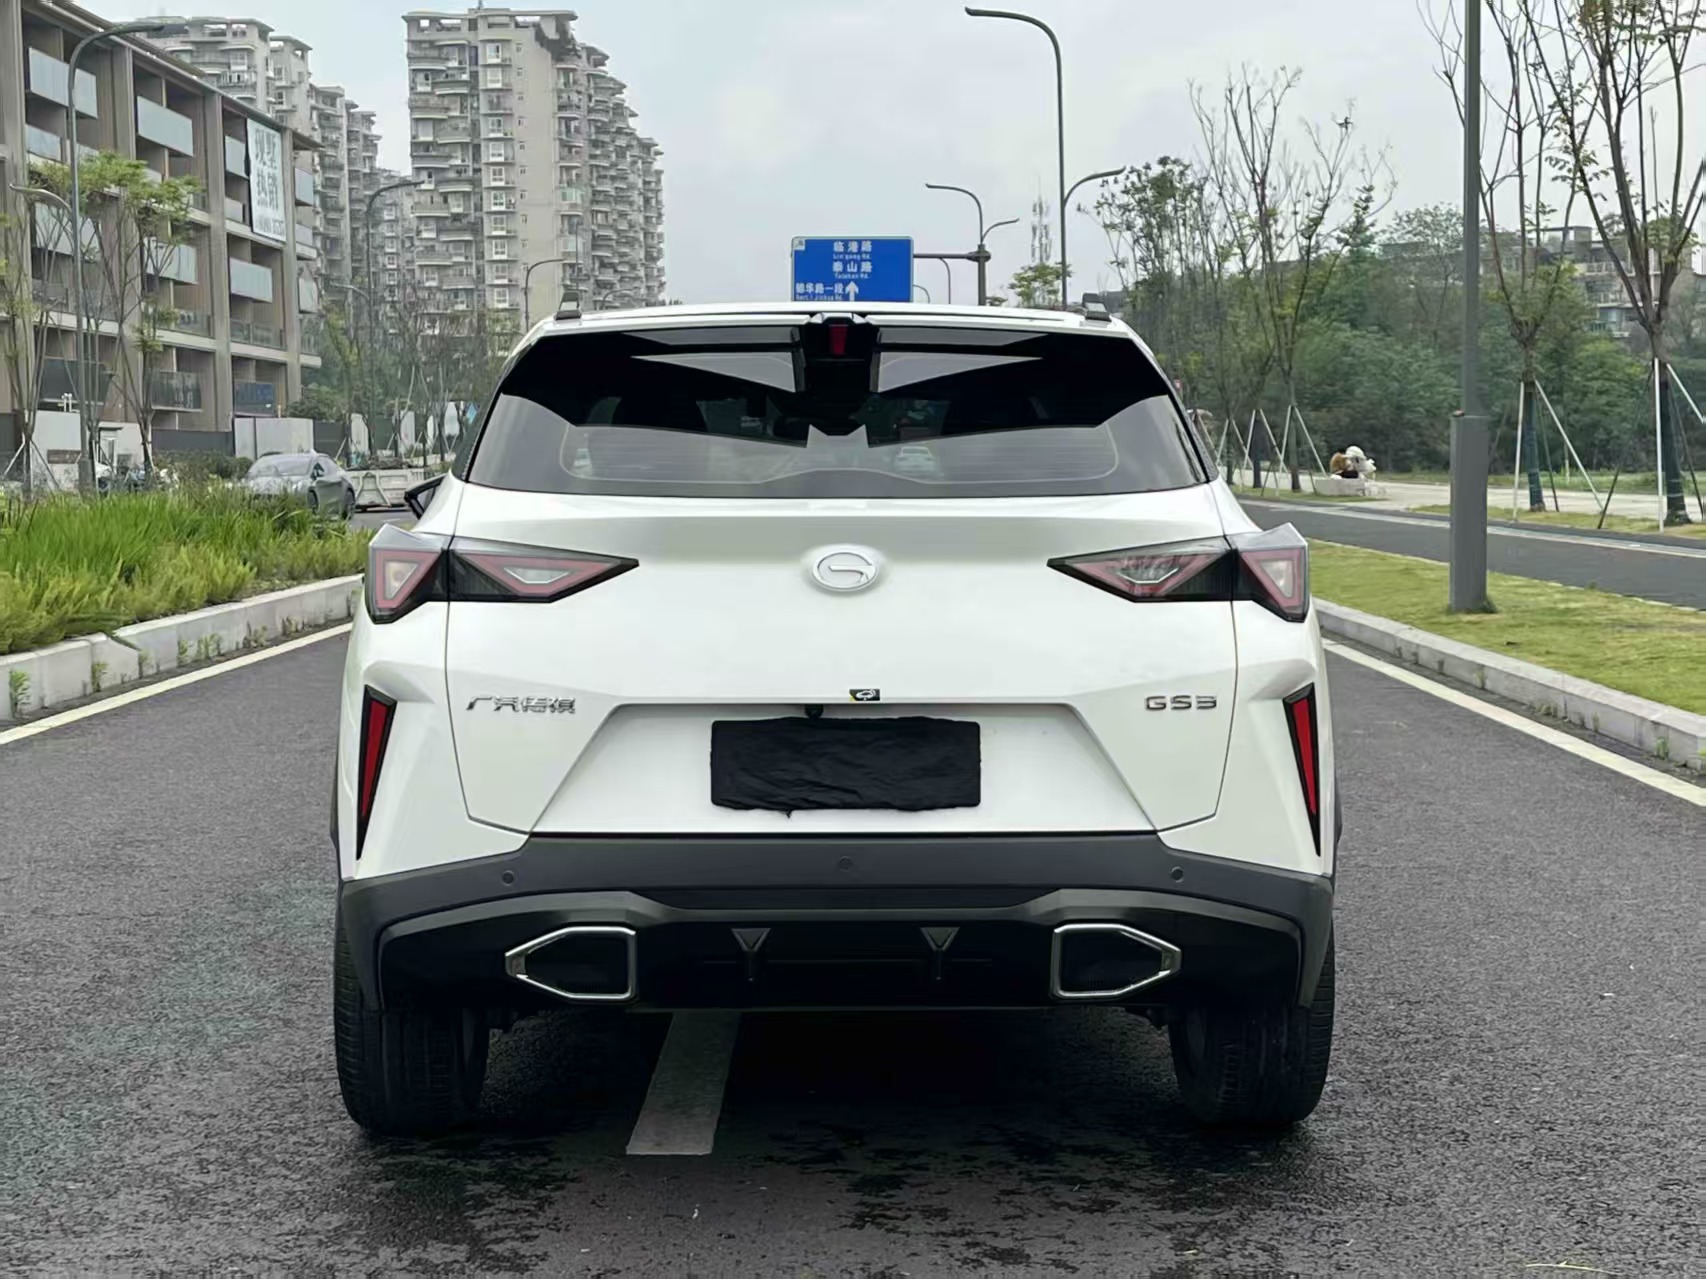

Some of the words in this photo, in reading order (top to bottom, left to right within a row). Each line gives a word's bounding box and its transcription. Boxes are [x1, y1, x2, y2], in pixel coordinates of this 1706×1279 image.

[833, 240, 873, 252] 临港路
[466, 696, 575, 714] 广汽传祺
[1146, 695, 1217, 711] GS3
